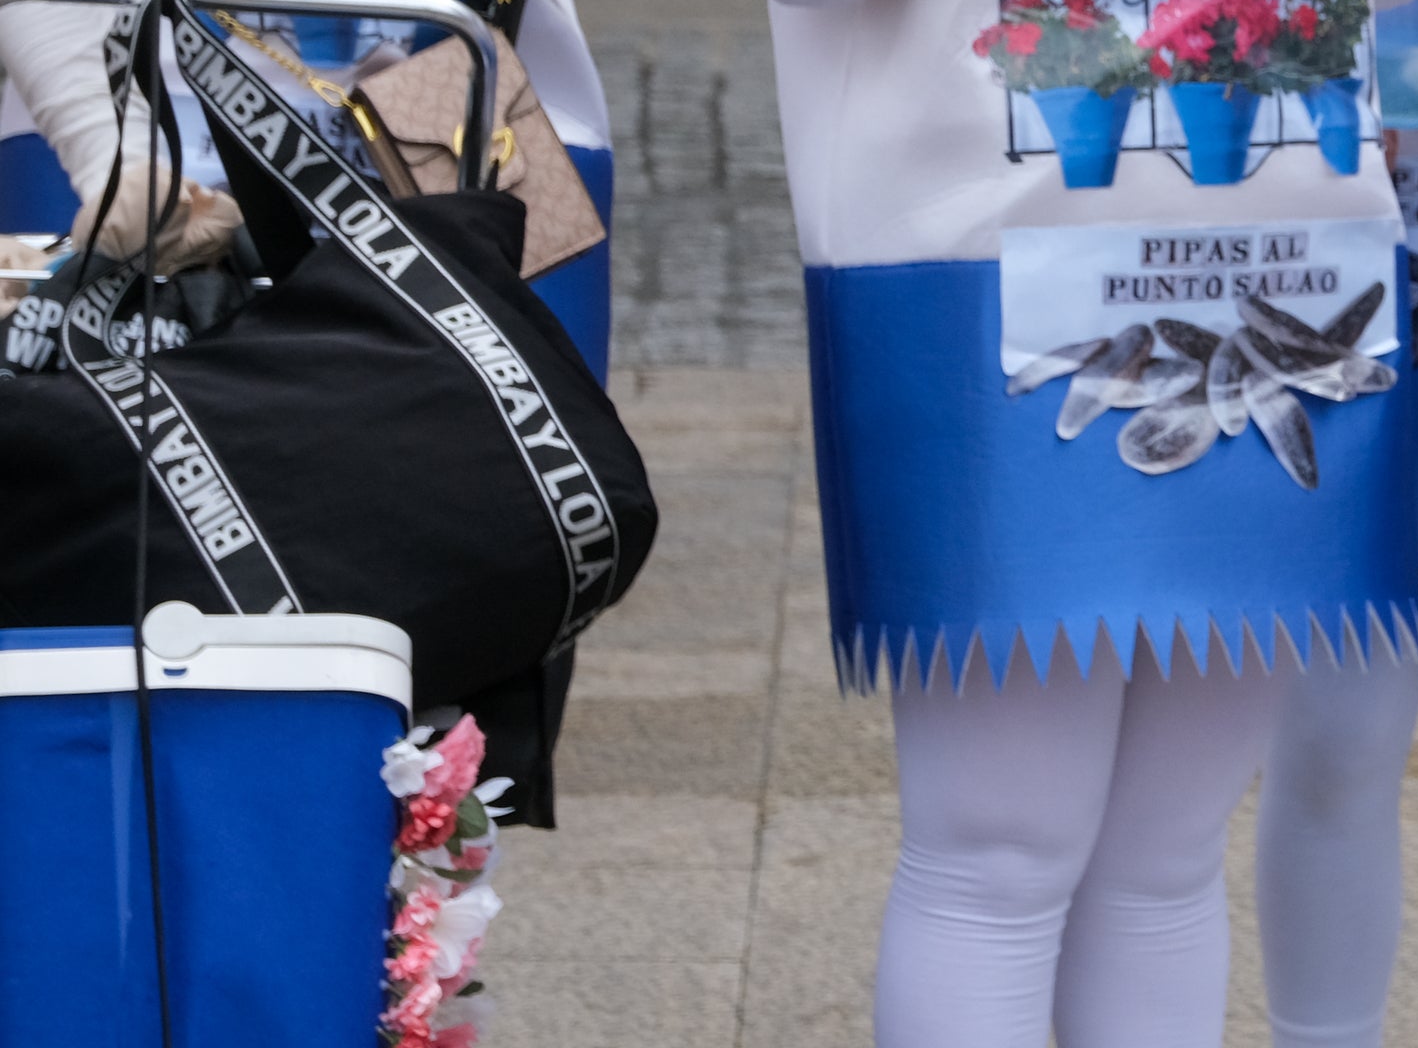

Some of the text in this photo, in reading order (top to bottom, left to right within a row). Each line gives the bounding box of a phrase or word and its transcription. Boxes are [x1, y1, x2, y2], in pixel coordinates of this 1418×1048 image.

[175, 19, 290, 161] BIMBA
[282, 133, 330, 180] Y
[314, 172, 421, 281] LOLA
[1108, 269, 1338, 302] PUNTO SALAO
[1143, 236, 1306, 264] PIPAS AL
[433, 303, 552, 427] BIMBA
[151, 422, 256, 561] BIMBA
[522, 425, 569, 452] Y
[542, 462, 614, 594] LOLA
